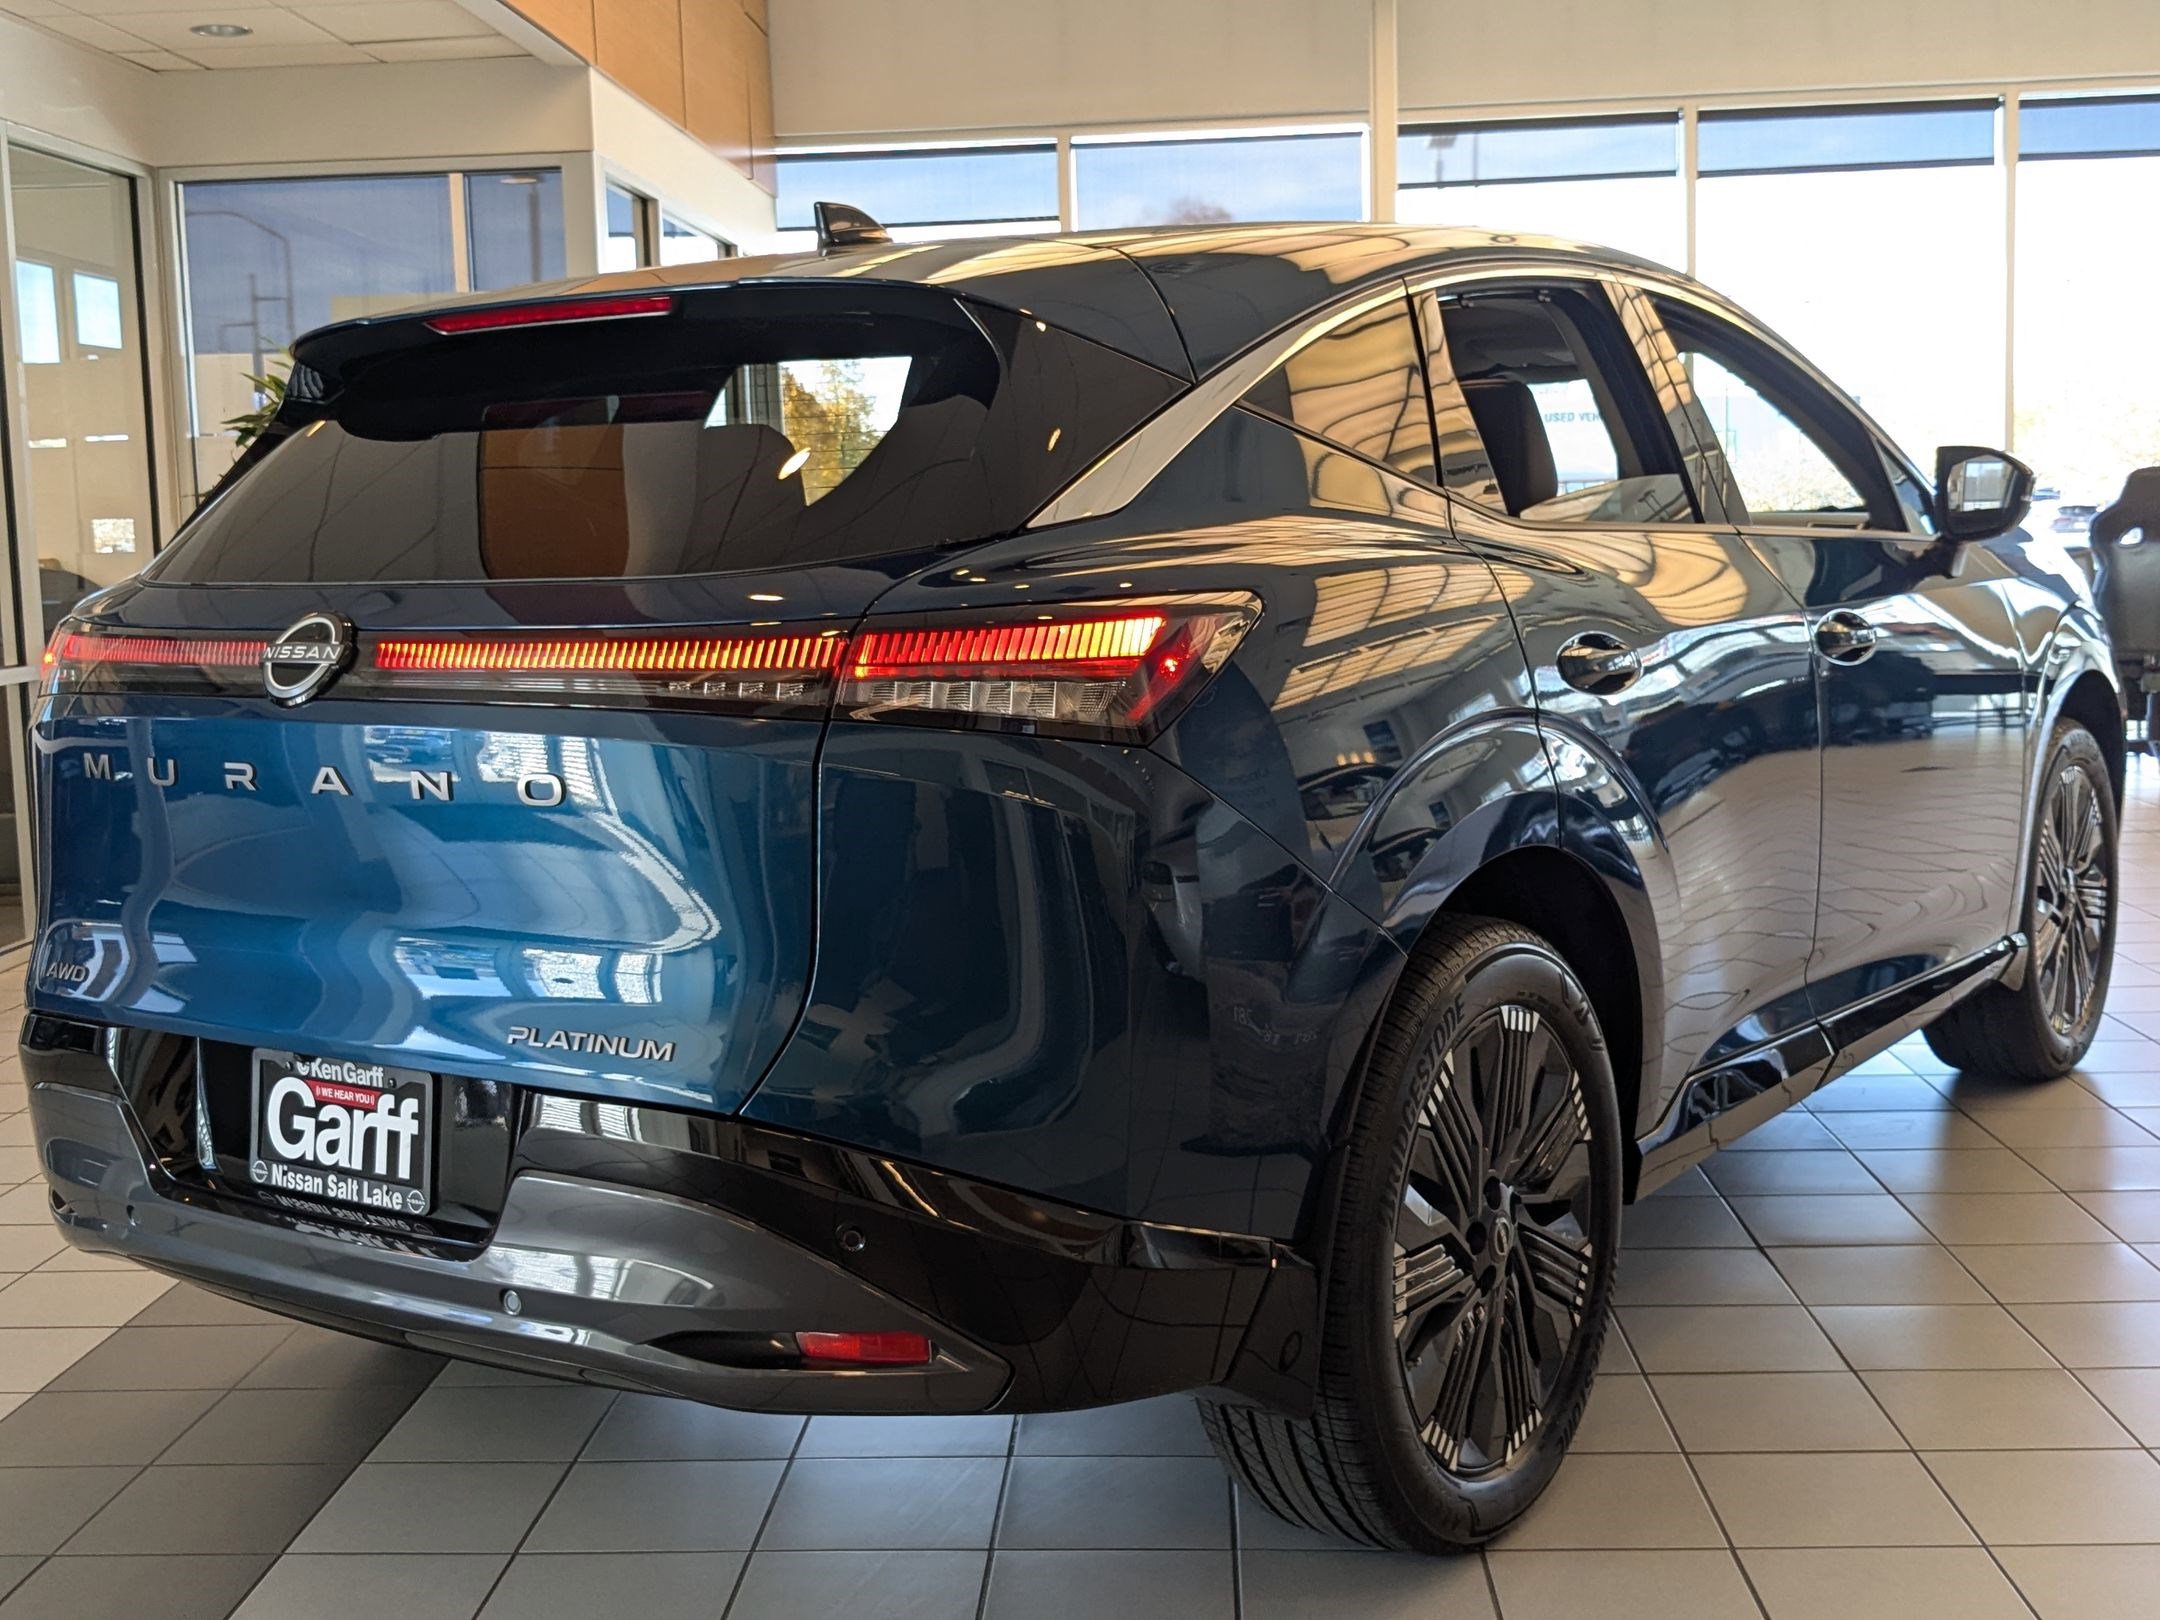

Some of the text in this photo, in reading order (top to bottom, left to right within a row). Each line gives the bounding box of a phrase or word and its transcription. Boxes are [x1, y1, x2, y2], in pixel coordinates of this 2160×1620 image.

[1544, 412, 1575, 423] USED
[263, 645, 340, 659] NISSAN
[82, 751, 567, 808] MURANO
[46, 962, 87, 982] AWD
[507, 1026, 675, 1062] PLATINUM
[310, 1058, 384, 1088] Ken Garff
[322, 1088, 370, 1103] WE HEAR YOU
[267, 1077, 419, 1180] Garff
[271, 1163, 402, 1209] Nissan Salt Lake
